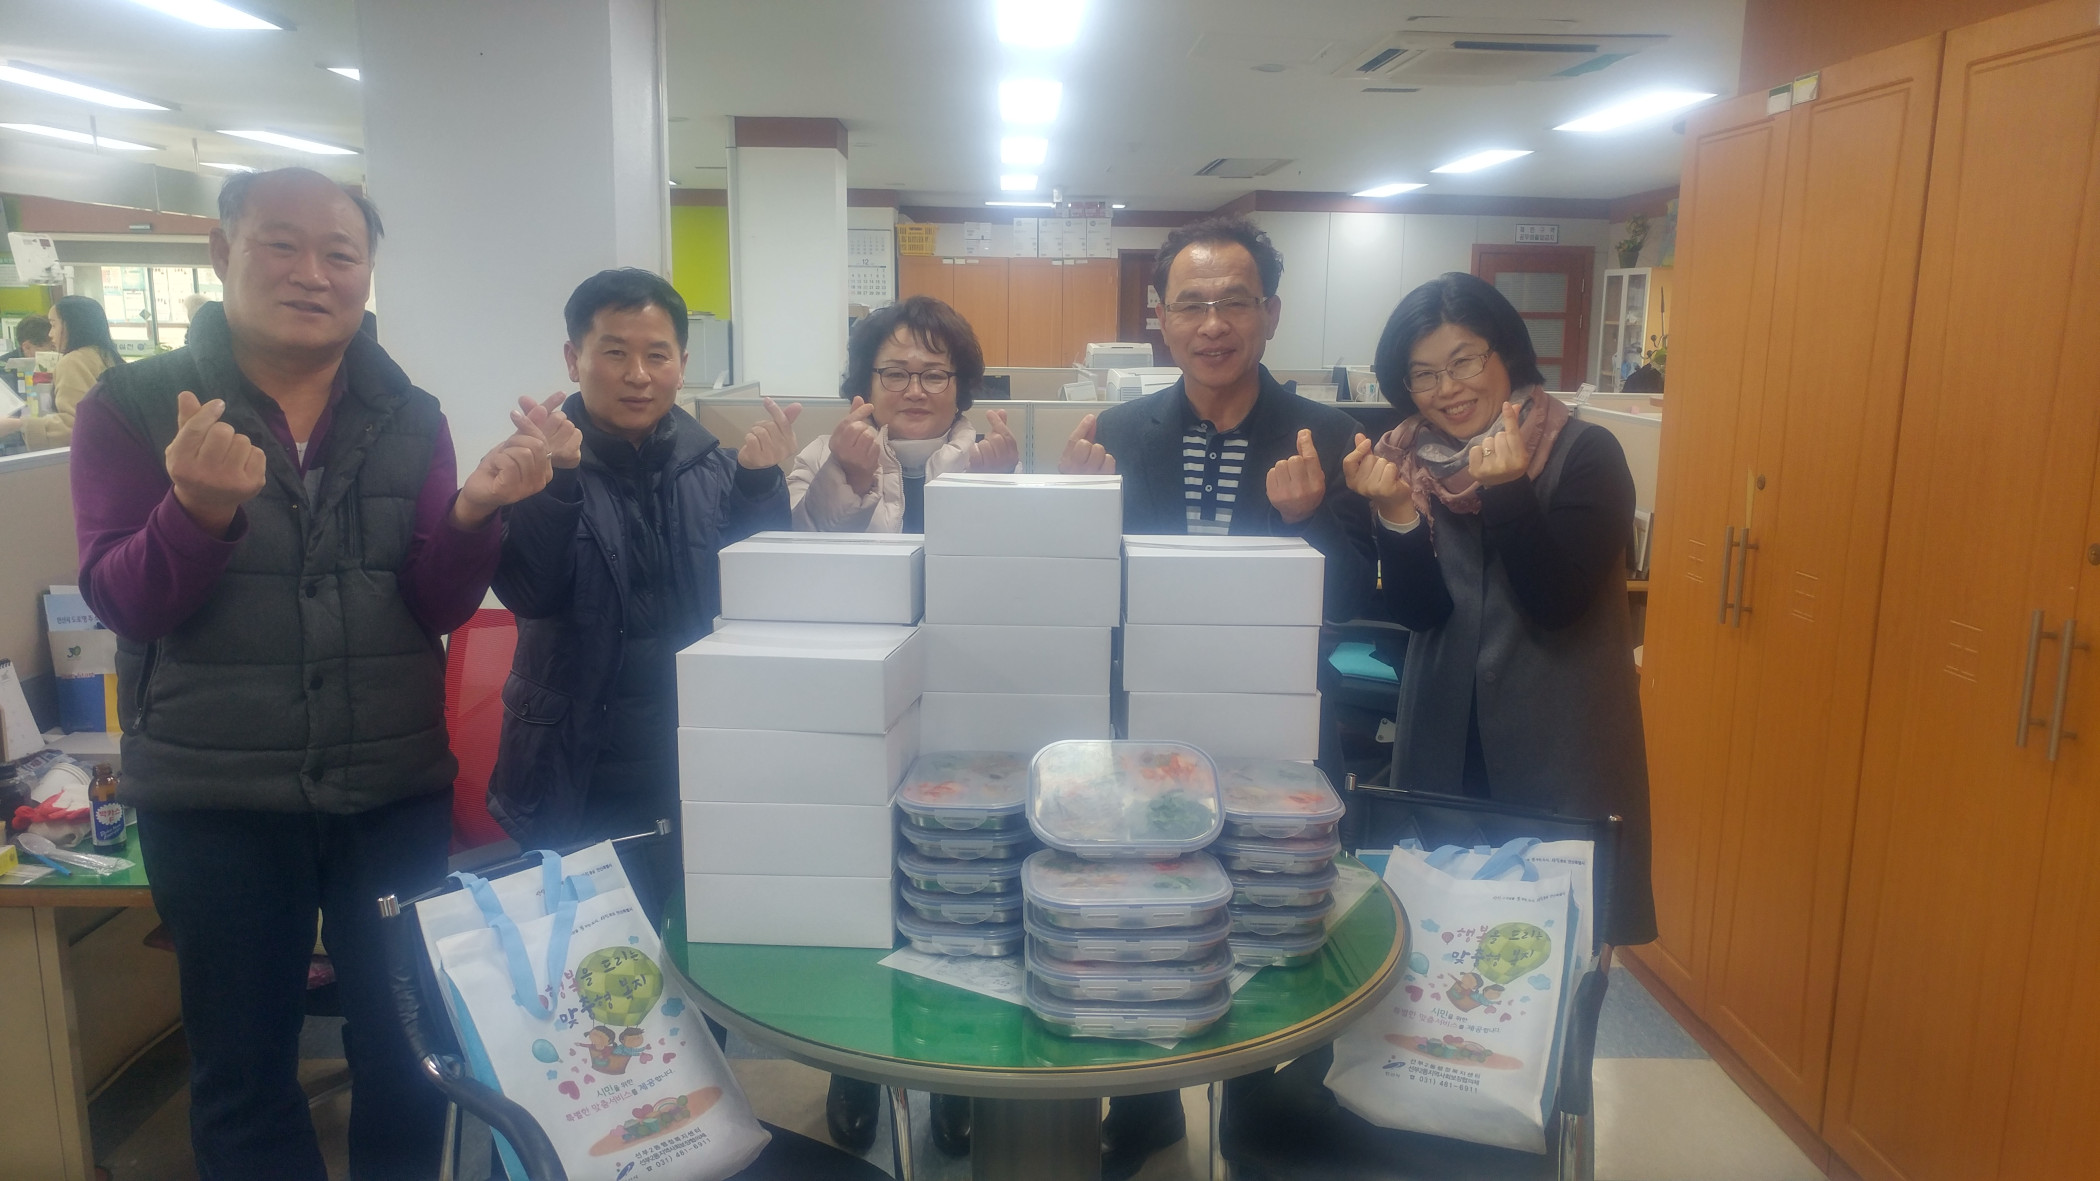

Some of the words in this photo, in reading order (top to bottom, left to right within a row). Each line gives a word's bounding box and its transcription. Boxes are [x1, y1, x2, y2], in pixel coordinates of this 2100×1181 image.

[99, 808, 121, 818] 박카스
[1457, 925, 1501, 945] 행복을
[1509, 929, 1543, 942] 드리는
[600, 950, 639, 973] 드리는
[1451, 946, 1501, 969] 맞춤형
[1509, 948, 1535, 967] 복지
[559, 991, 614, 1029] 맞춤형
[619, 973, 647, 1001] 복지
[596, 1085, 620, 1098] 시민을
